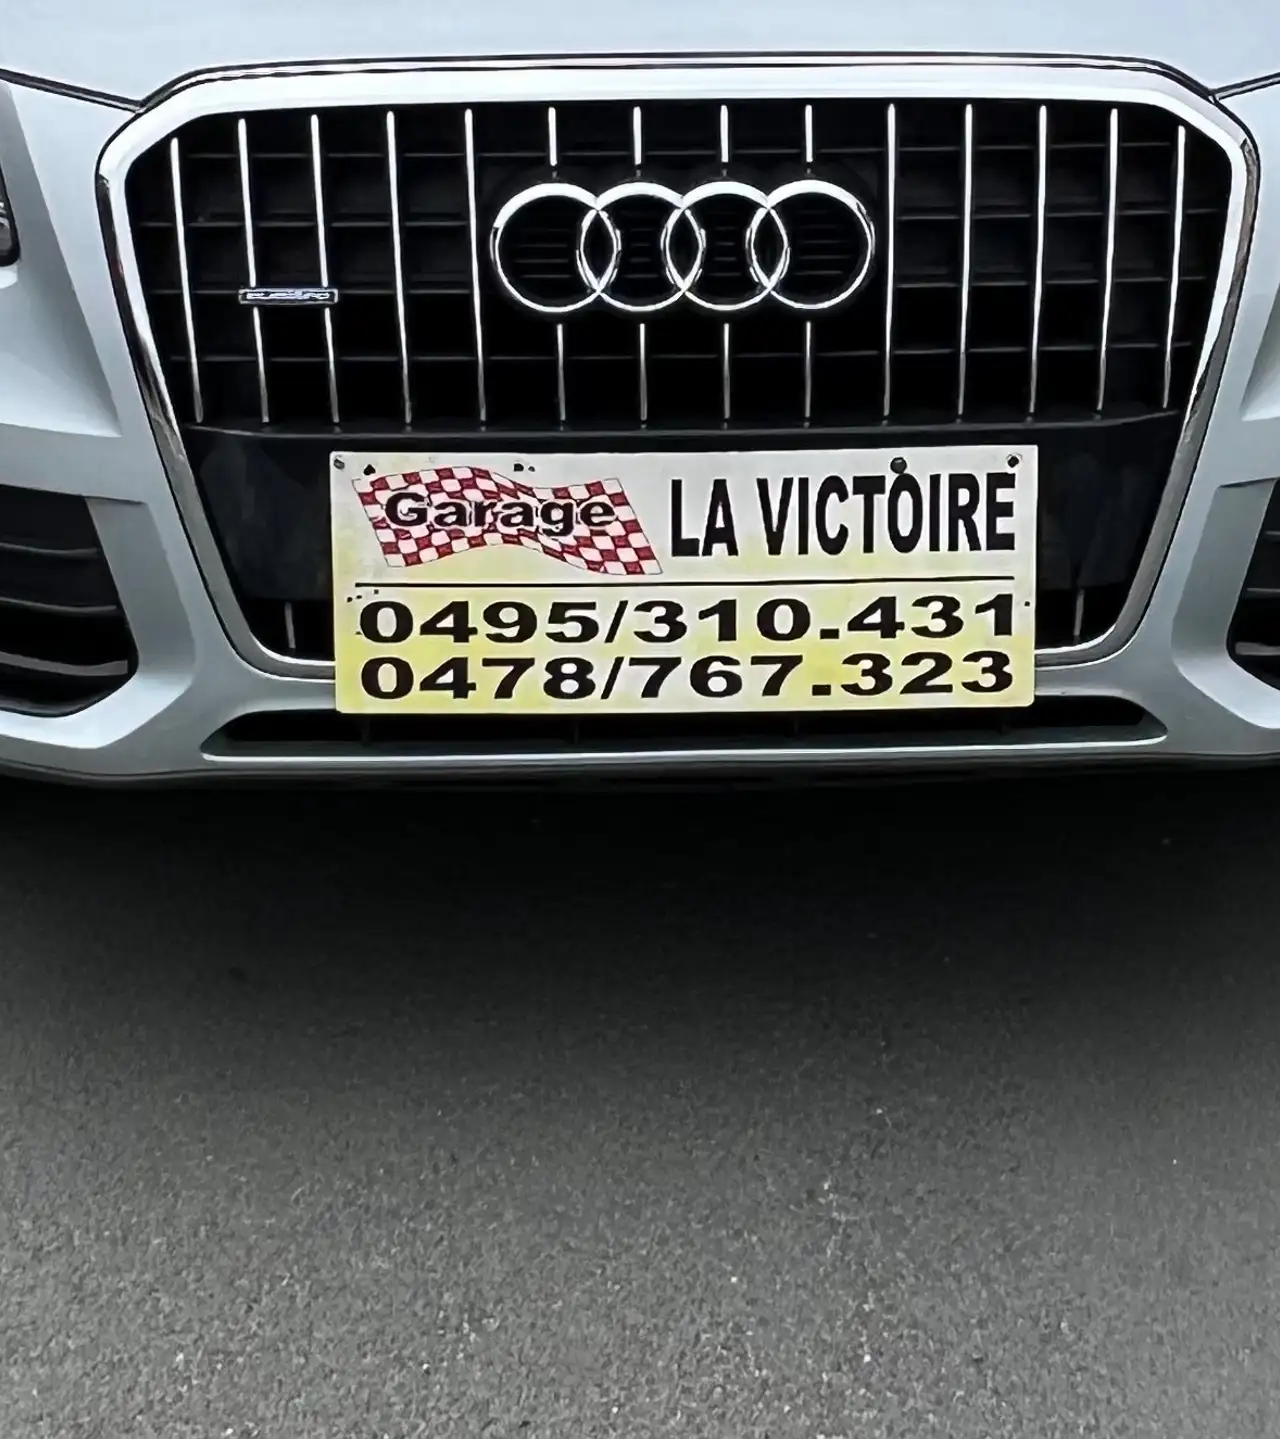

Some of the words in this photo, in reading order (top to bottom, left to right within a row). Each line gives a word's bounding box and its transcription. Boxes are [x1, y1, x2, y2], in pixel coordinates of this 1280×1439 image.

[384, 490, 617, 537] Garage
[670, 477, 739, 557] LA
[757, 469, 1017, 556] VICTOIRE
[358, 593, 1014, 646] 0495/310.431
[360, 650, 1014, 701] 0478/767.323
